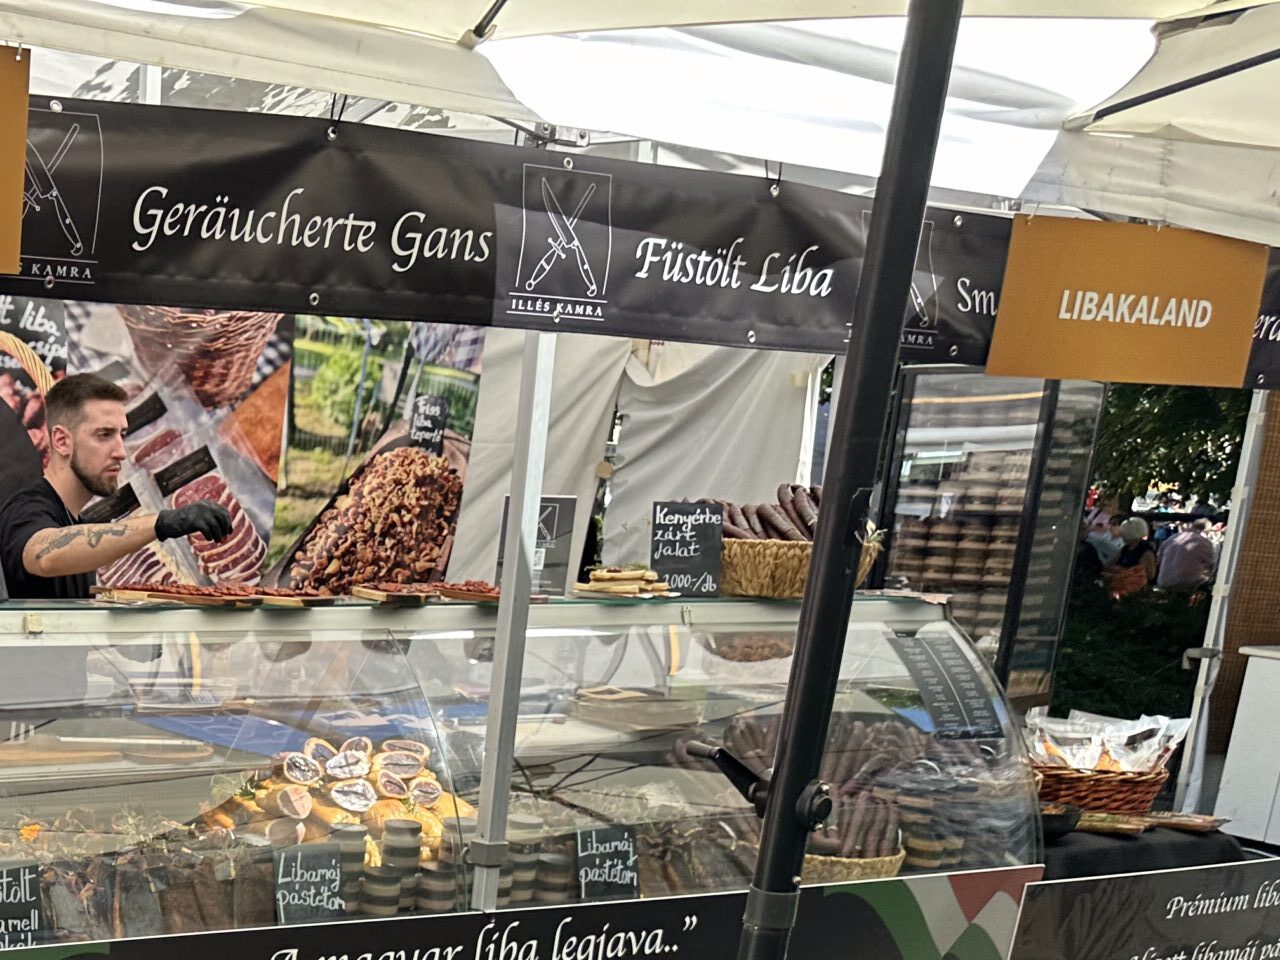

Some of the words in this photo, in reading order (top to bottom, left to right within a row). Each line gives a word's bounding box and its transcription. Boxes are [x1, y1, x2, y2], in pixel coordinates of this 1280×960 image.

[132, 186, 376, 251] Geräucherte
[390, 211, 494, 273] Gans
[31, 263, 92, 279] KAMRA
[634, 235, 746, 289] Füstölt
[750, 244, 835, 298] Liba
[511, 298, 551, 312] ILLÉS
[556, 302, 603, 317] KAMRA
[1058, 289, 1213, 329] LIBAKALAND
[655, 505, 722, 532] Kenyérbe
[577, 829, 639, 867] Libamáj
[277, 851, 341, 893] Libamáj
[1165, 893, 1250, 920] Prémium
